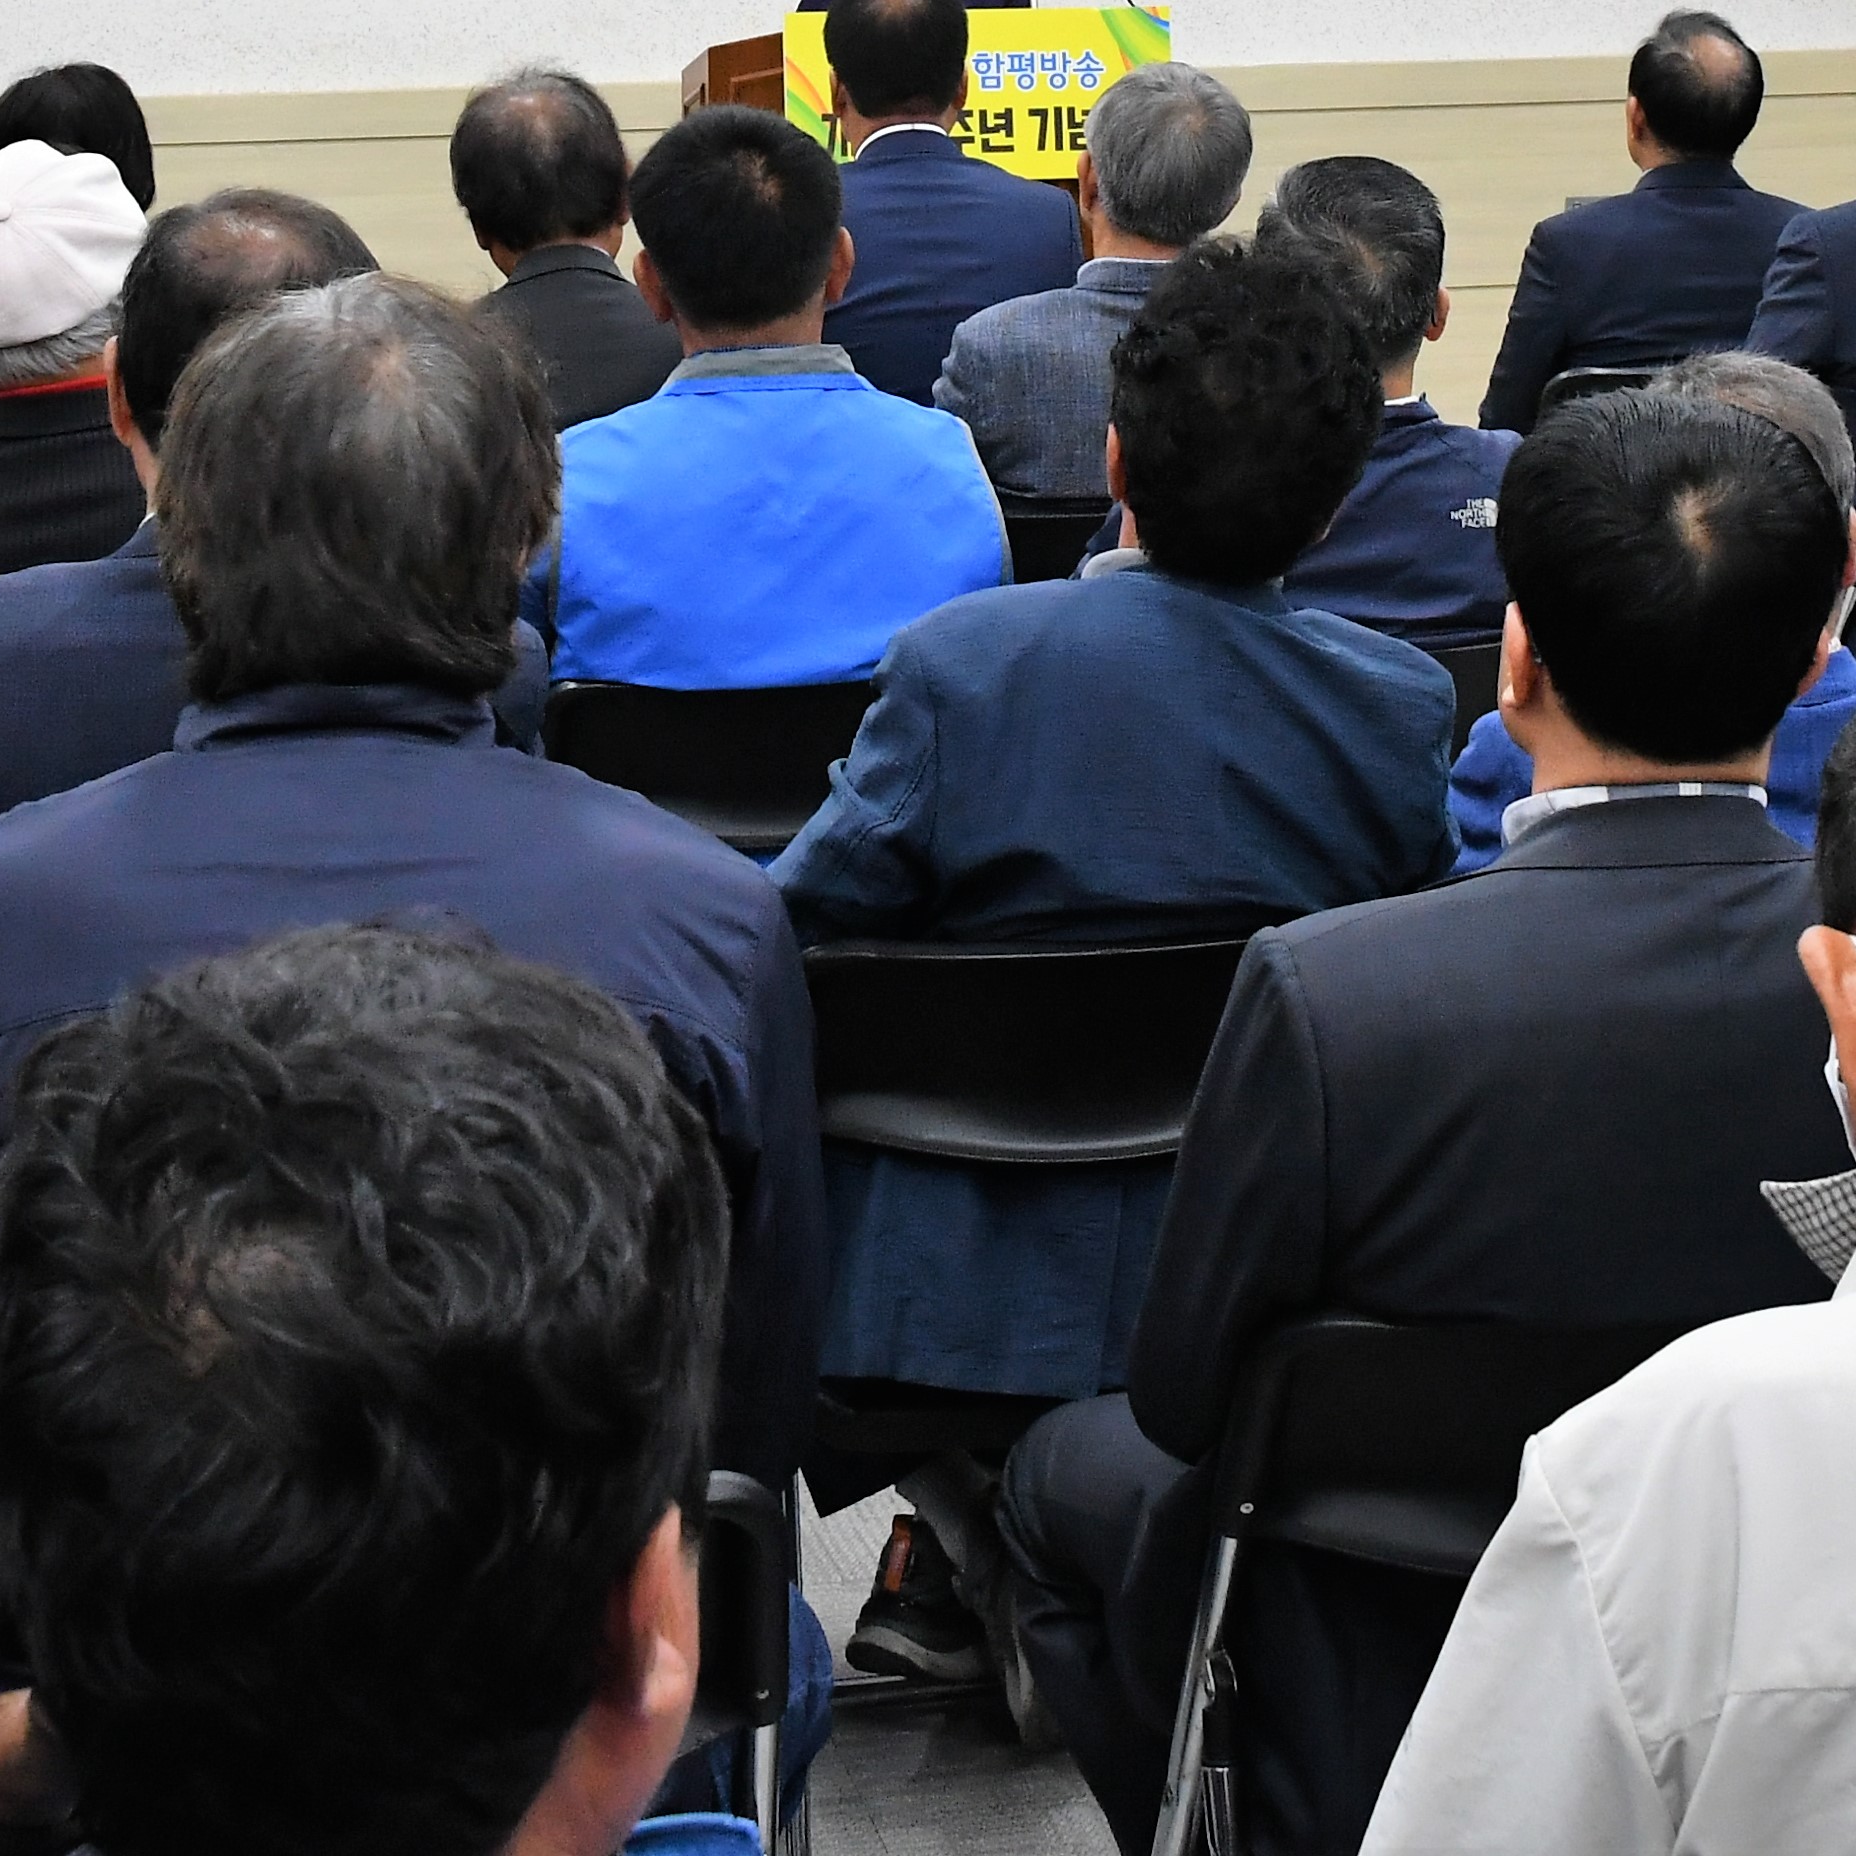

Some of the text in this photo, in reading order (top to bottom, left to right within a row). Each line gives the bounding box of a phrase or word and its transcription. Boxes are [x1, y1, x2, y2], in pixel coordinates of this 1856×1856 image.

[972, 53, 1104, 89] 함평방송
[1028, 106, 1089, 151] 기념
[1450, 509, 1485, 520] NORTH
